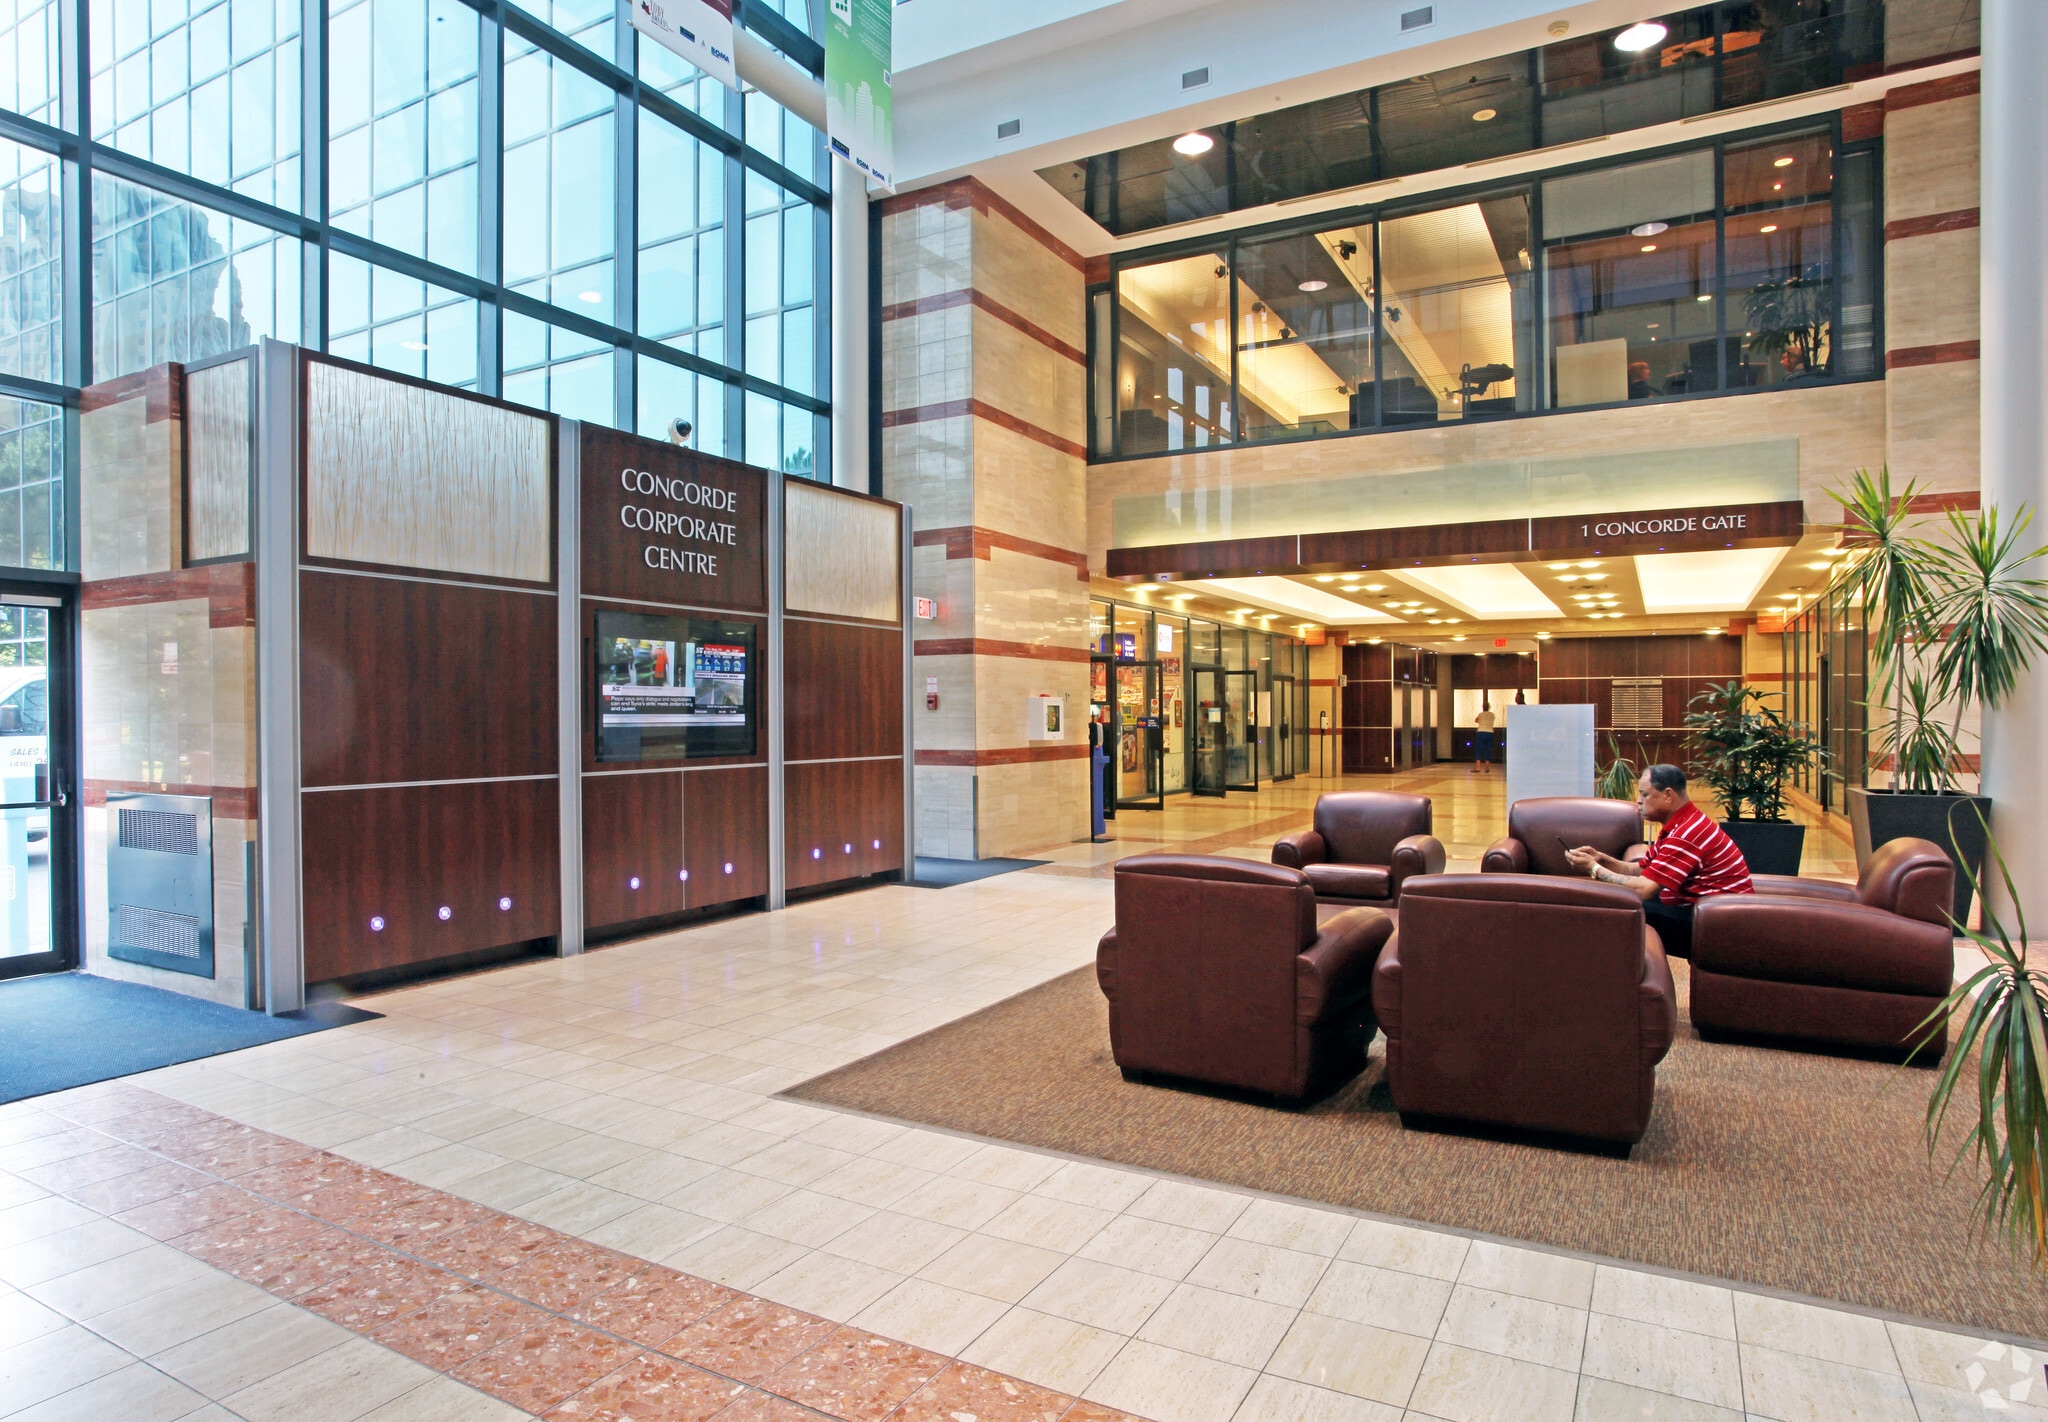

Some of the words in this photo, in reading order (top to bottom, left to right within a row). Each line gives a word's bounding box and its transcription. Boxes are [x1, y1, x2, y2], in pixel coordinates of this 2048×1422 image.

[710, 46, 730, 63] BOMA
[856, 157, 870, 171] BOMA
[872, 168, 886, 182] BOMA
[621, 468, 737, 513] CONCORDE
[620, 505, 737, 546] CORPORATE
[1581, 525, 1588, 537] 1
[1595, 517, 1697, 537] CONCORDE
[1702, 514, 1747, 531] GATE
[644, 545, 718, 576] CENTRE
[918, 599, 932, 618] EXIT
[1495, 638, 1507, 648] EXIT
[10, 748, 39, 756] SALES
[10, 760, 32, 768] (416)
